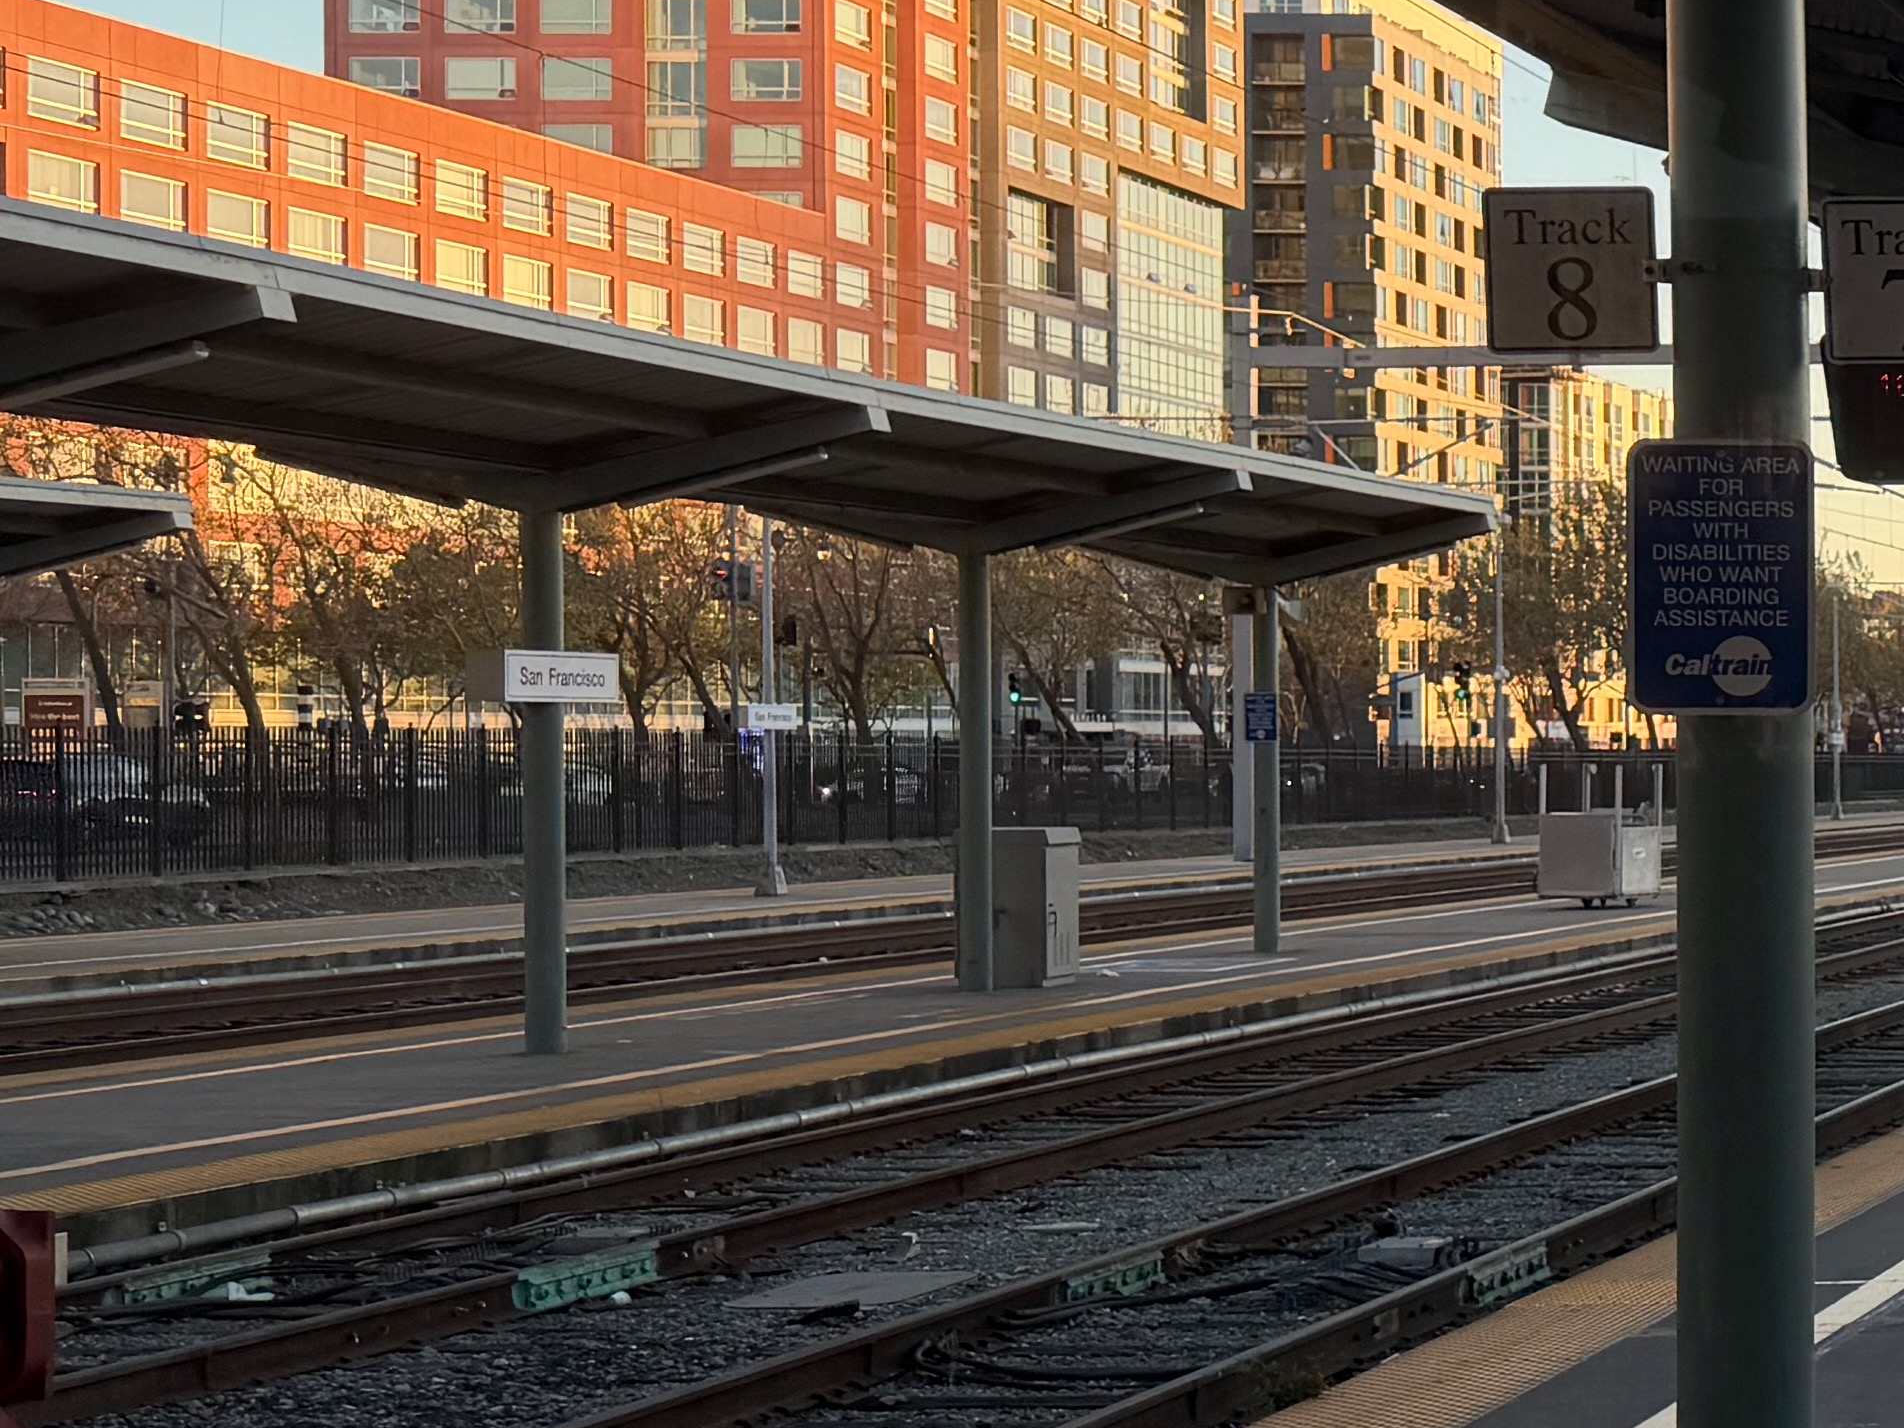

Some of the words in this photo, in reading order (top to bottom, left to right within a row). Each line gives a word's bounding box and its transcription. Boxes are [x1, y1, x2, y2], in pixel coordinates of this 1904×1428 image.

[1504, 207, 1632, 245] Track
[1547, 257, 1597, 341] 8
[1642, 456, 1735, 474] WAITING
[1741, 456, 1800, 474] AREA
[1700, 478, 1743, 496] FOR
[1648, 499, 1794, 518] PASSENGERS
[1693, 521, 1749, 540] WITH
[1652, 543, 1790, 562] DISABILITIES
[1659, 565, 1712, 584] WHO
[1719, 565, 1783, 584] WANT
[1663, 587, 1780, 605] BOARDING
[1653, 609, 1788, 627] ASSISTANCE
[1664, 652, 1772, 676] Caltrain
[520, 666, 543, 685] San
[549, 667, 606, 687] Francisco
